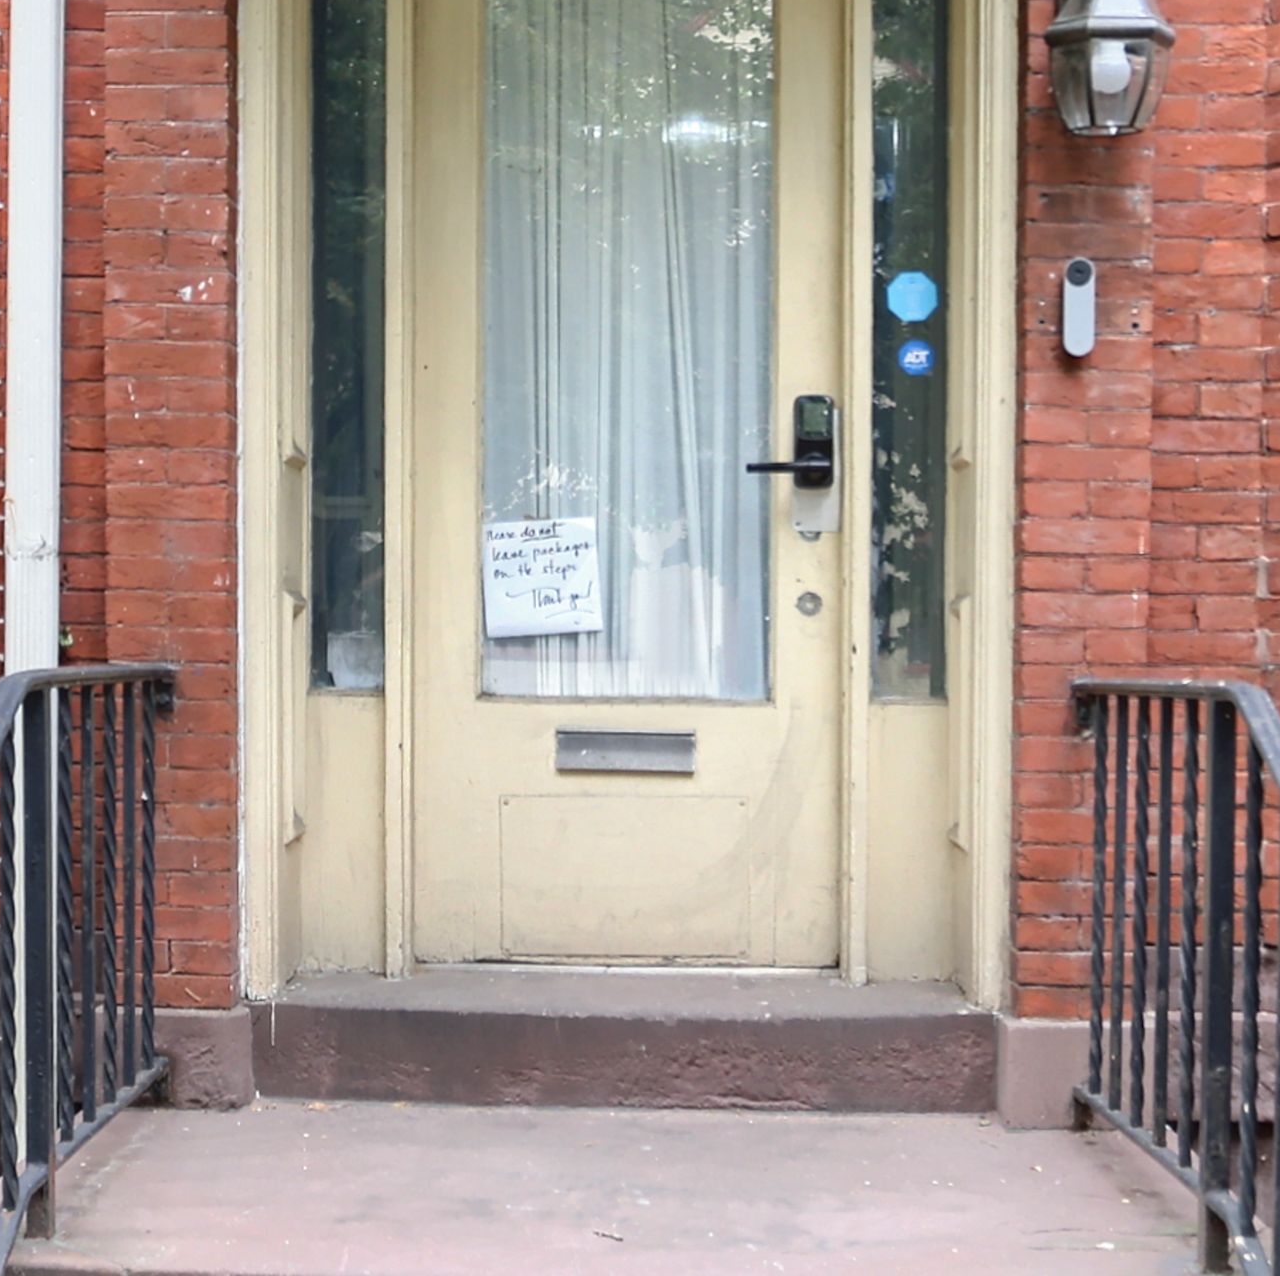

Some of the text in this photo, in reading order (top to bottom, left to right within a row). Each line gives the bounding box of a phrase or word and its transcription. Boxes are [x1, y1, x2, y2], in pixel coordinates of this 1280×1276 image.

[903, 350, 930, 364] ADT
[520, 524, 536, 538] do
[538, 522, 564, 537] not
[492, 542, 592, 562] leave packages
[493, 560, 578, 580] on the steps
